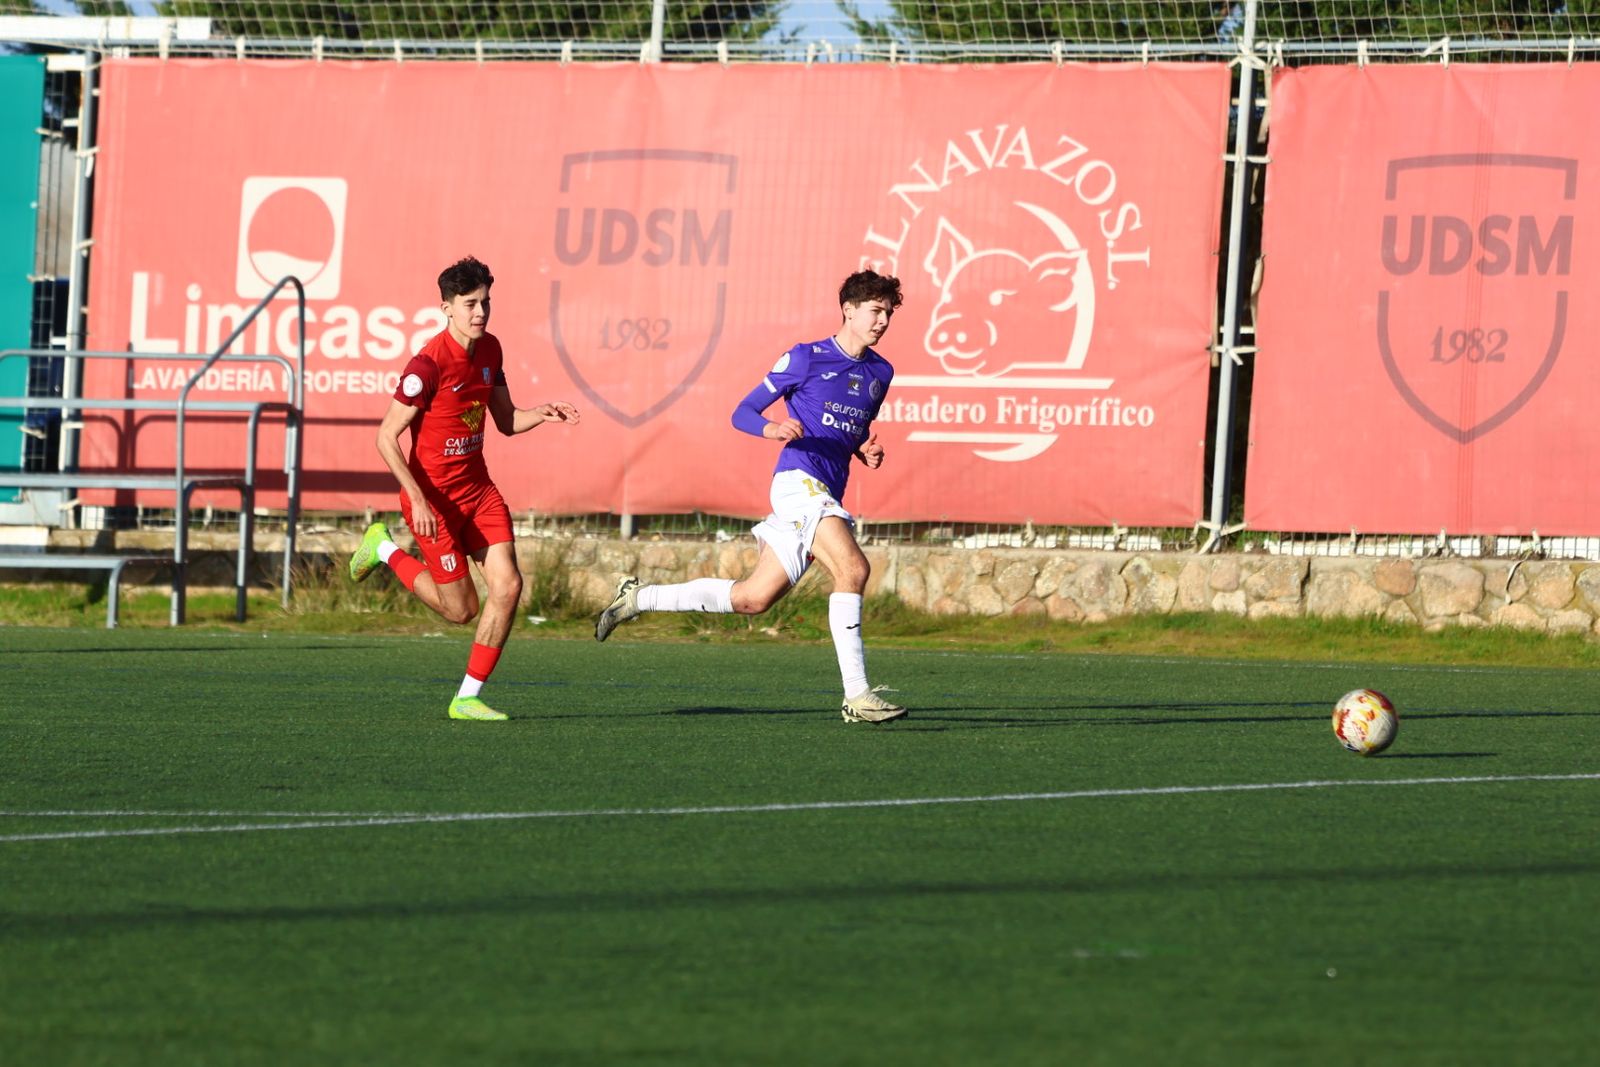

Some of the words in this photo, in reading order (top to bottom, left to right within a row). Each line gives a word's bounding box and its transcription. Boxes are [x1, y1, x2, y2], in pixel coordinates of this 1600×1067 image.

[888, 123, 1117, 219] NAVAZO
[1099, 201, 1151, 291] S.L.
[553, 207, 733, 268] UDSM
[1380, 214, 1575, 277] UDSM
[129, 271, 448, 361] Limcasa
[598, 316, 673, 351] 1982
[1429, 325, 1510, 365] 1982
[129, 364, 274, 391] LAVANDERÍA
[876, 395, 987, 424] atadero
[994, 395, 1154, 432] Frigorífico
